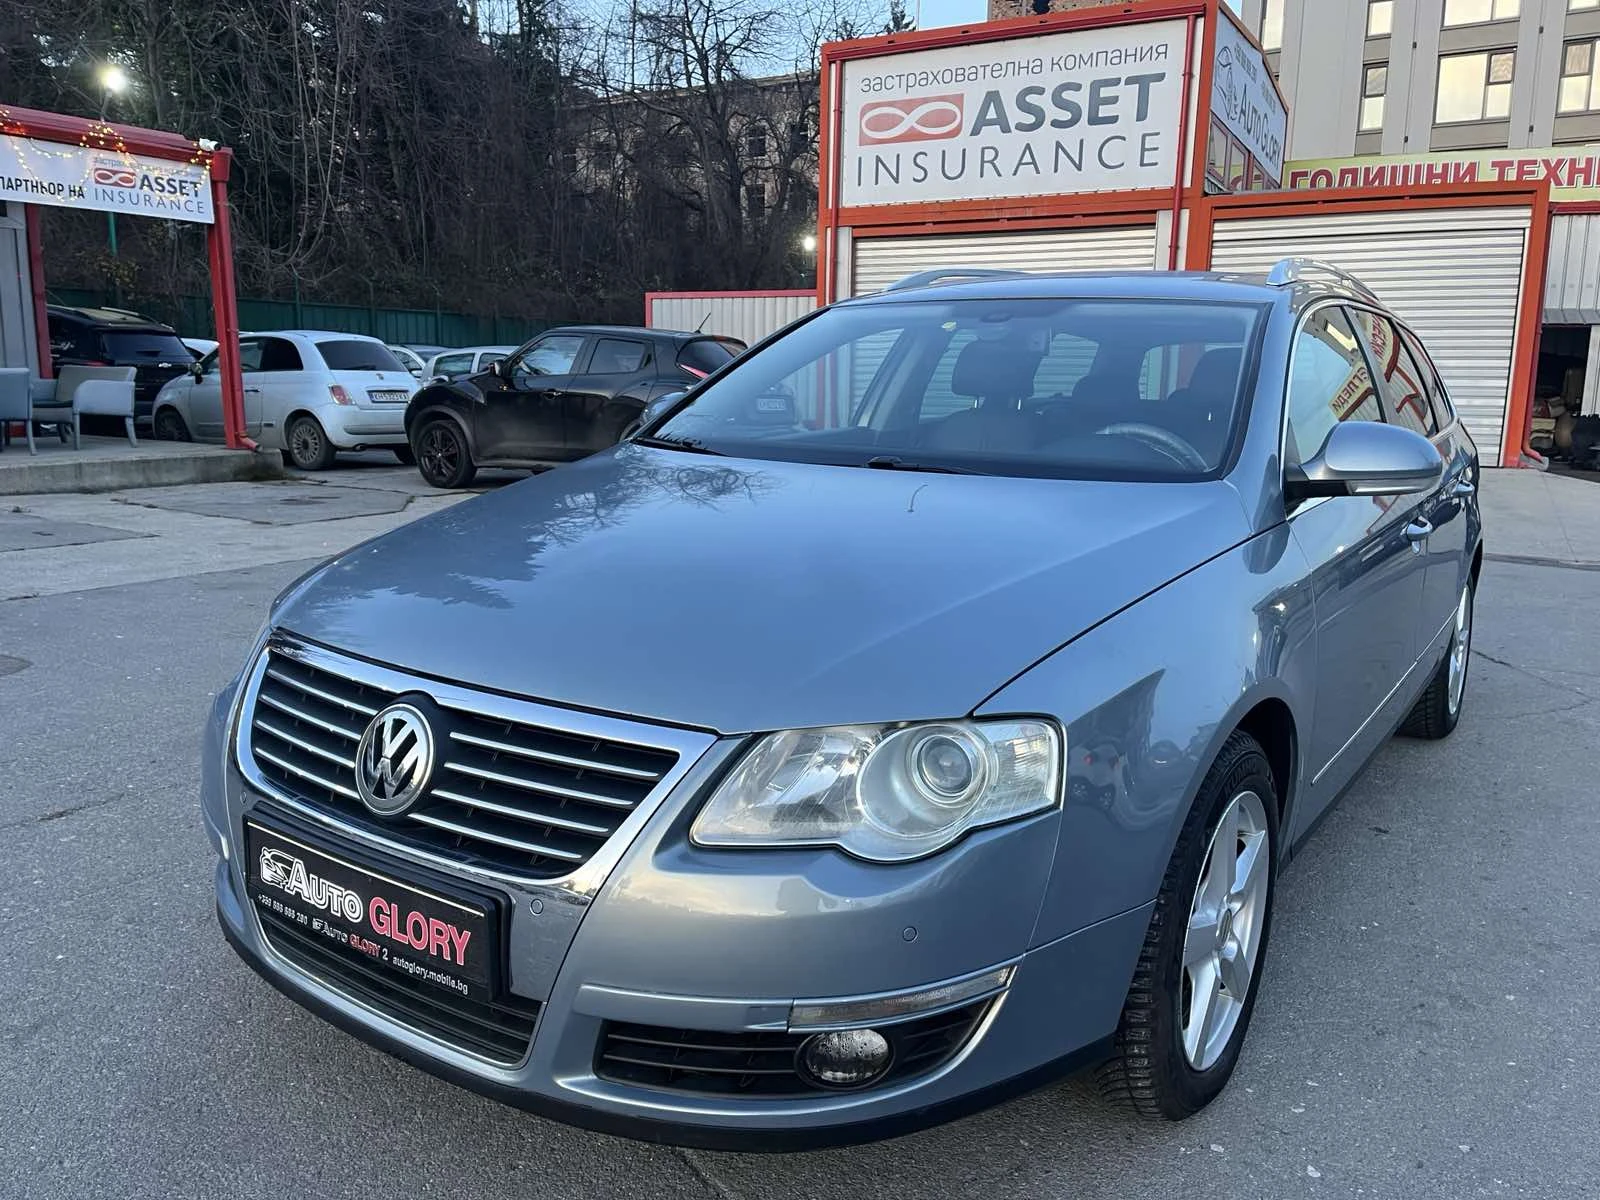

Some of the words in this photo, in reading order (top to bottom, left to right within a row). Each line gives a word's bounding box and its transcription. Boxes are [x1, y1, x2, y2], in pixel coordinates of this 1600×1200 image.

[860, 56, 1043, 94] застрахователна
[1050, 43, 1169, 73] компания
[970, 71, 1167, 137] ASSET
[857, 131, 1162, 187] INSURANCE
[69, 184, 85, 199] НА
[95, 188, 205, 214] INSURANCE
[139, 173, 204, 199] ASSET
[368, 896, 472, 967] GLORY
[349, 932, 381, 958] GLORY
[381, 947, 389, 961] 2
[392, 955, 469, 996] autoglory.mobile.bg
